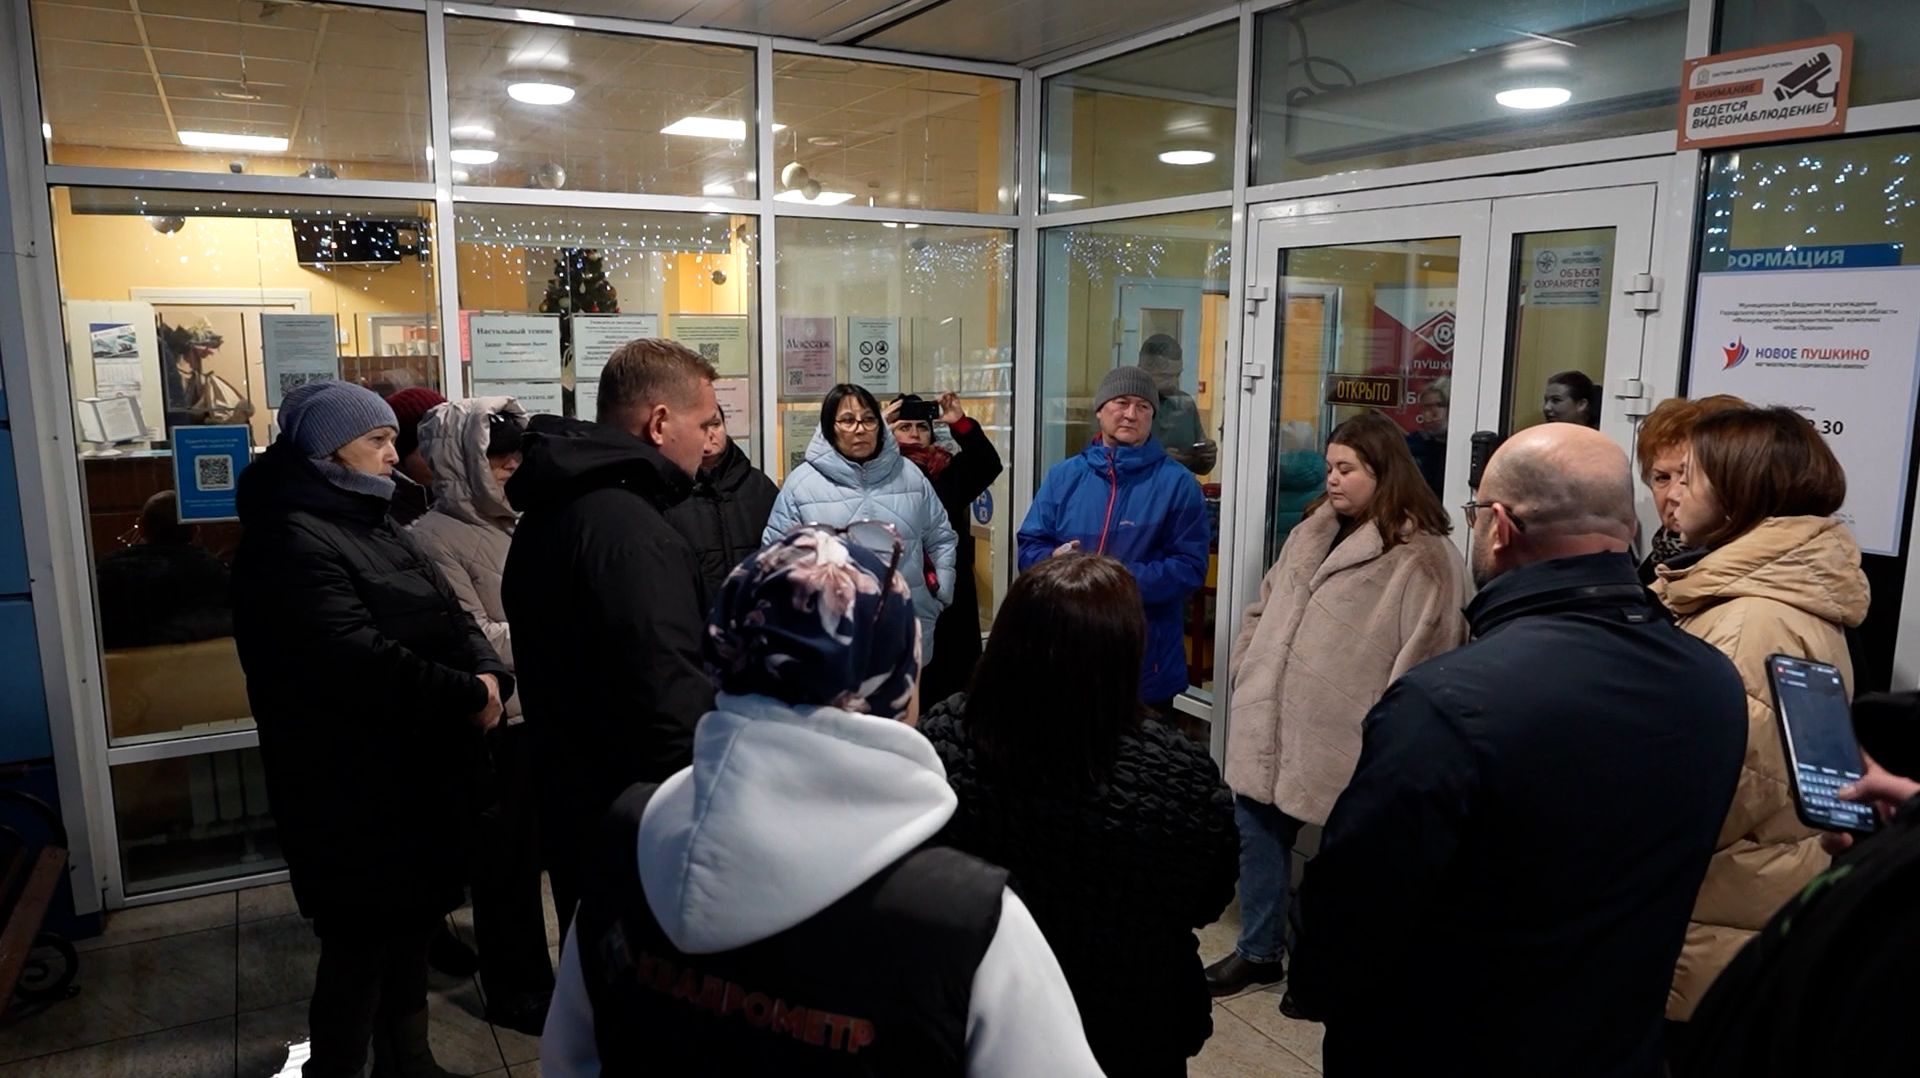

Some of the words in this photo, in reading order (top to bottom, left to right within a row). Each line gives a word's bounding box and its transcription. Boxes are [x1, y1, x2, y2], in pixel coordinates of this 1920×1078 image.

[1694, 83, 1756, 101] ВНИМАНИЕ
[1691, 102, 1830, 129] ВИДЕОНАБЛЮДЕНИЕ!
[1692, 101, 1748, 118] ВЕДЕТСЯ
[1560, 268, 1601, 278] ОБЪЕКТ
[1534, 279, 1600, 289] ОХРАНЯЕТСЯ
[1755, 347, 1798, 359] НОВОЕ
[1801, 347, 1870, 361] ПУШКИНО
[1336, 380, 1391, 402] ОТКРЫТО
[636, 949, 877, 1055] КВАДРОМЕТР
